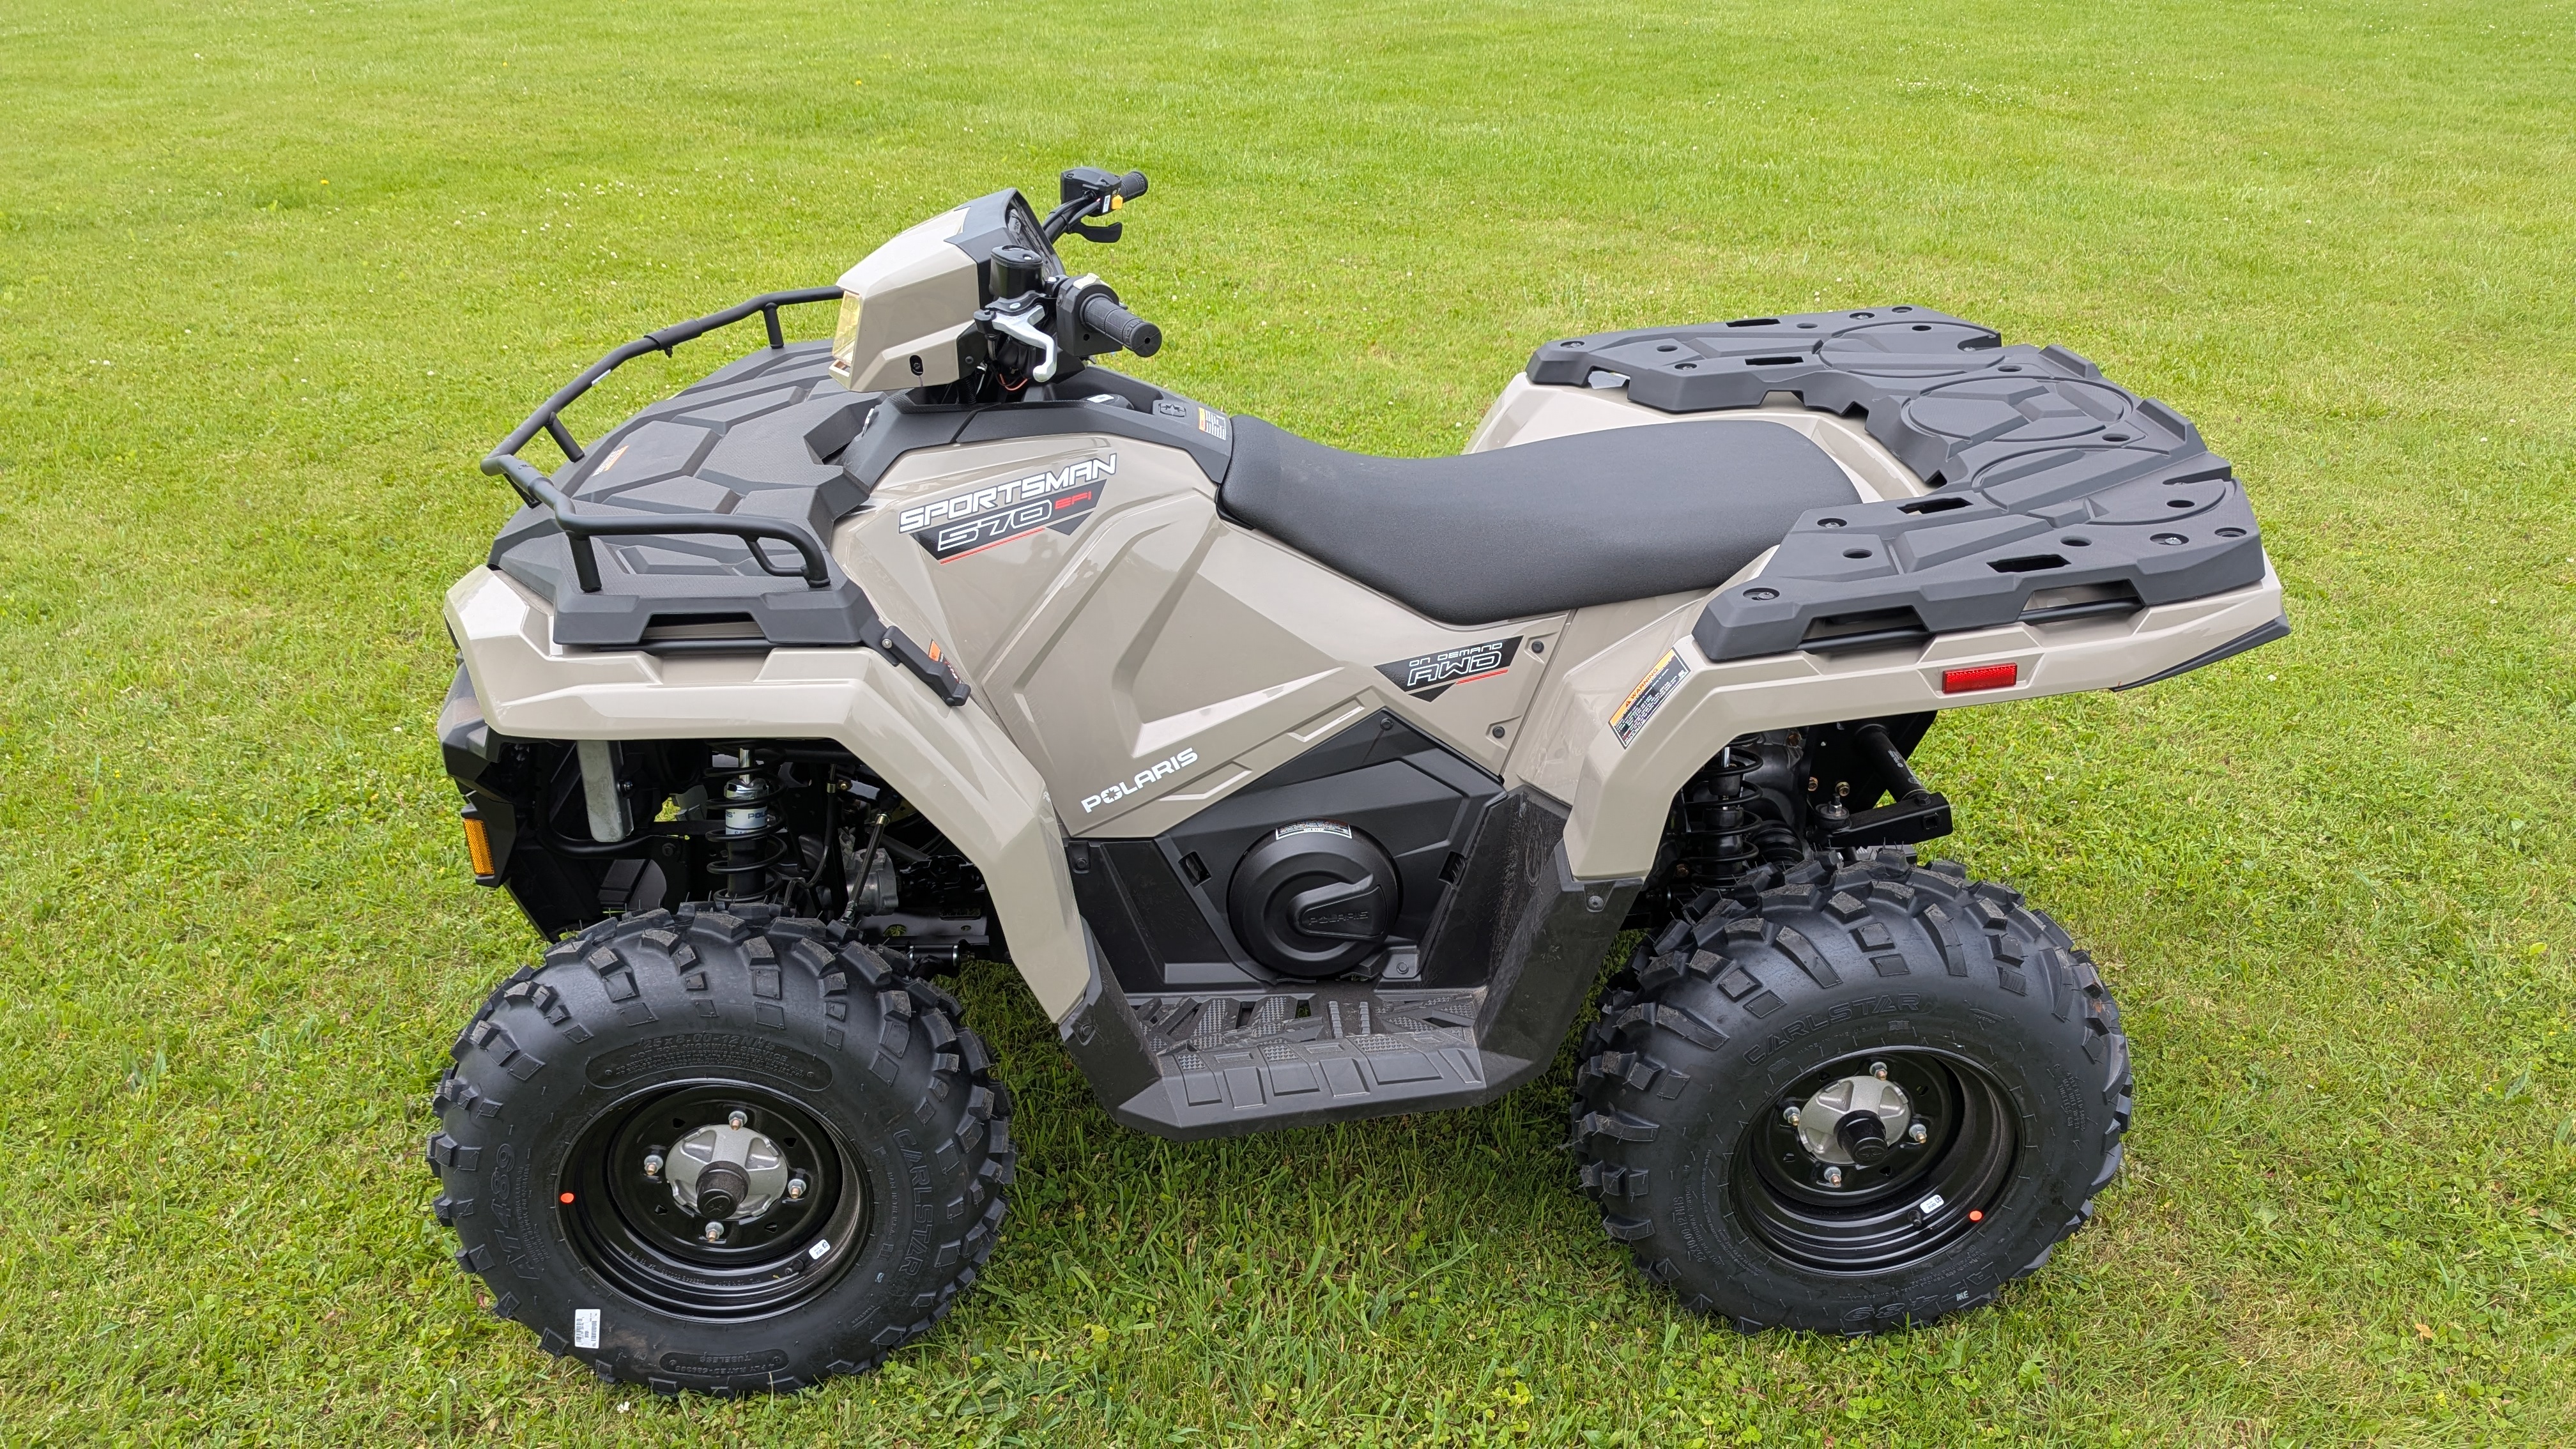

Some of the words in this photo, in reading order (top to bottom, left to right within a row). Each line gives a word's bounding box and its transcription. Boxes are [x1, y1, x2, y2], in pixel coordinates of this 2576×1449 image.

[900, 454, 1117, 531] SPORTSMAN
[937, 499, 1052, 551] 570
[1055, 491, 1092, 510] EFI
[1407, 652, 1501, 686] AWD
[1409, 656, 1431, 667] ON
[1437, 642, 1503, 661] DEMAND
[1630, 668, 1659, 699] WARNING
[1081, 747, 1198, 813] POLARIS
[1308, 911, 1368, 925] POLARIS
[683, 1043, 735, 1051] HIGHWAY
[740, 1046, 788, 1062] SERVICE
[1743, 993, 1921, 1066] CARLSTAR
[893, 1128, 934, 1276] CARLSTAR
